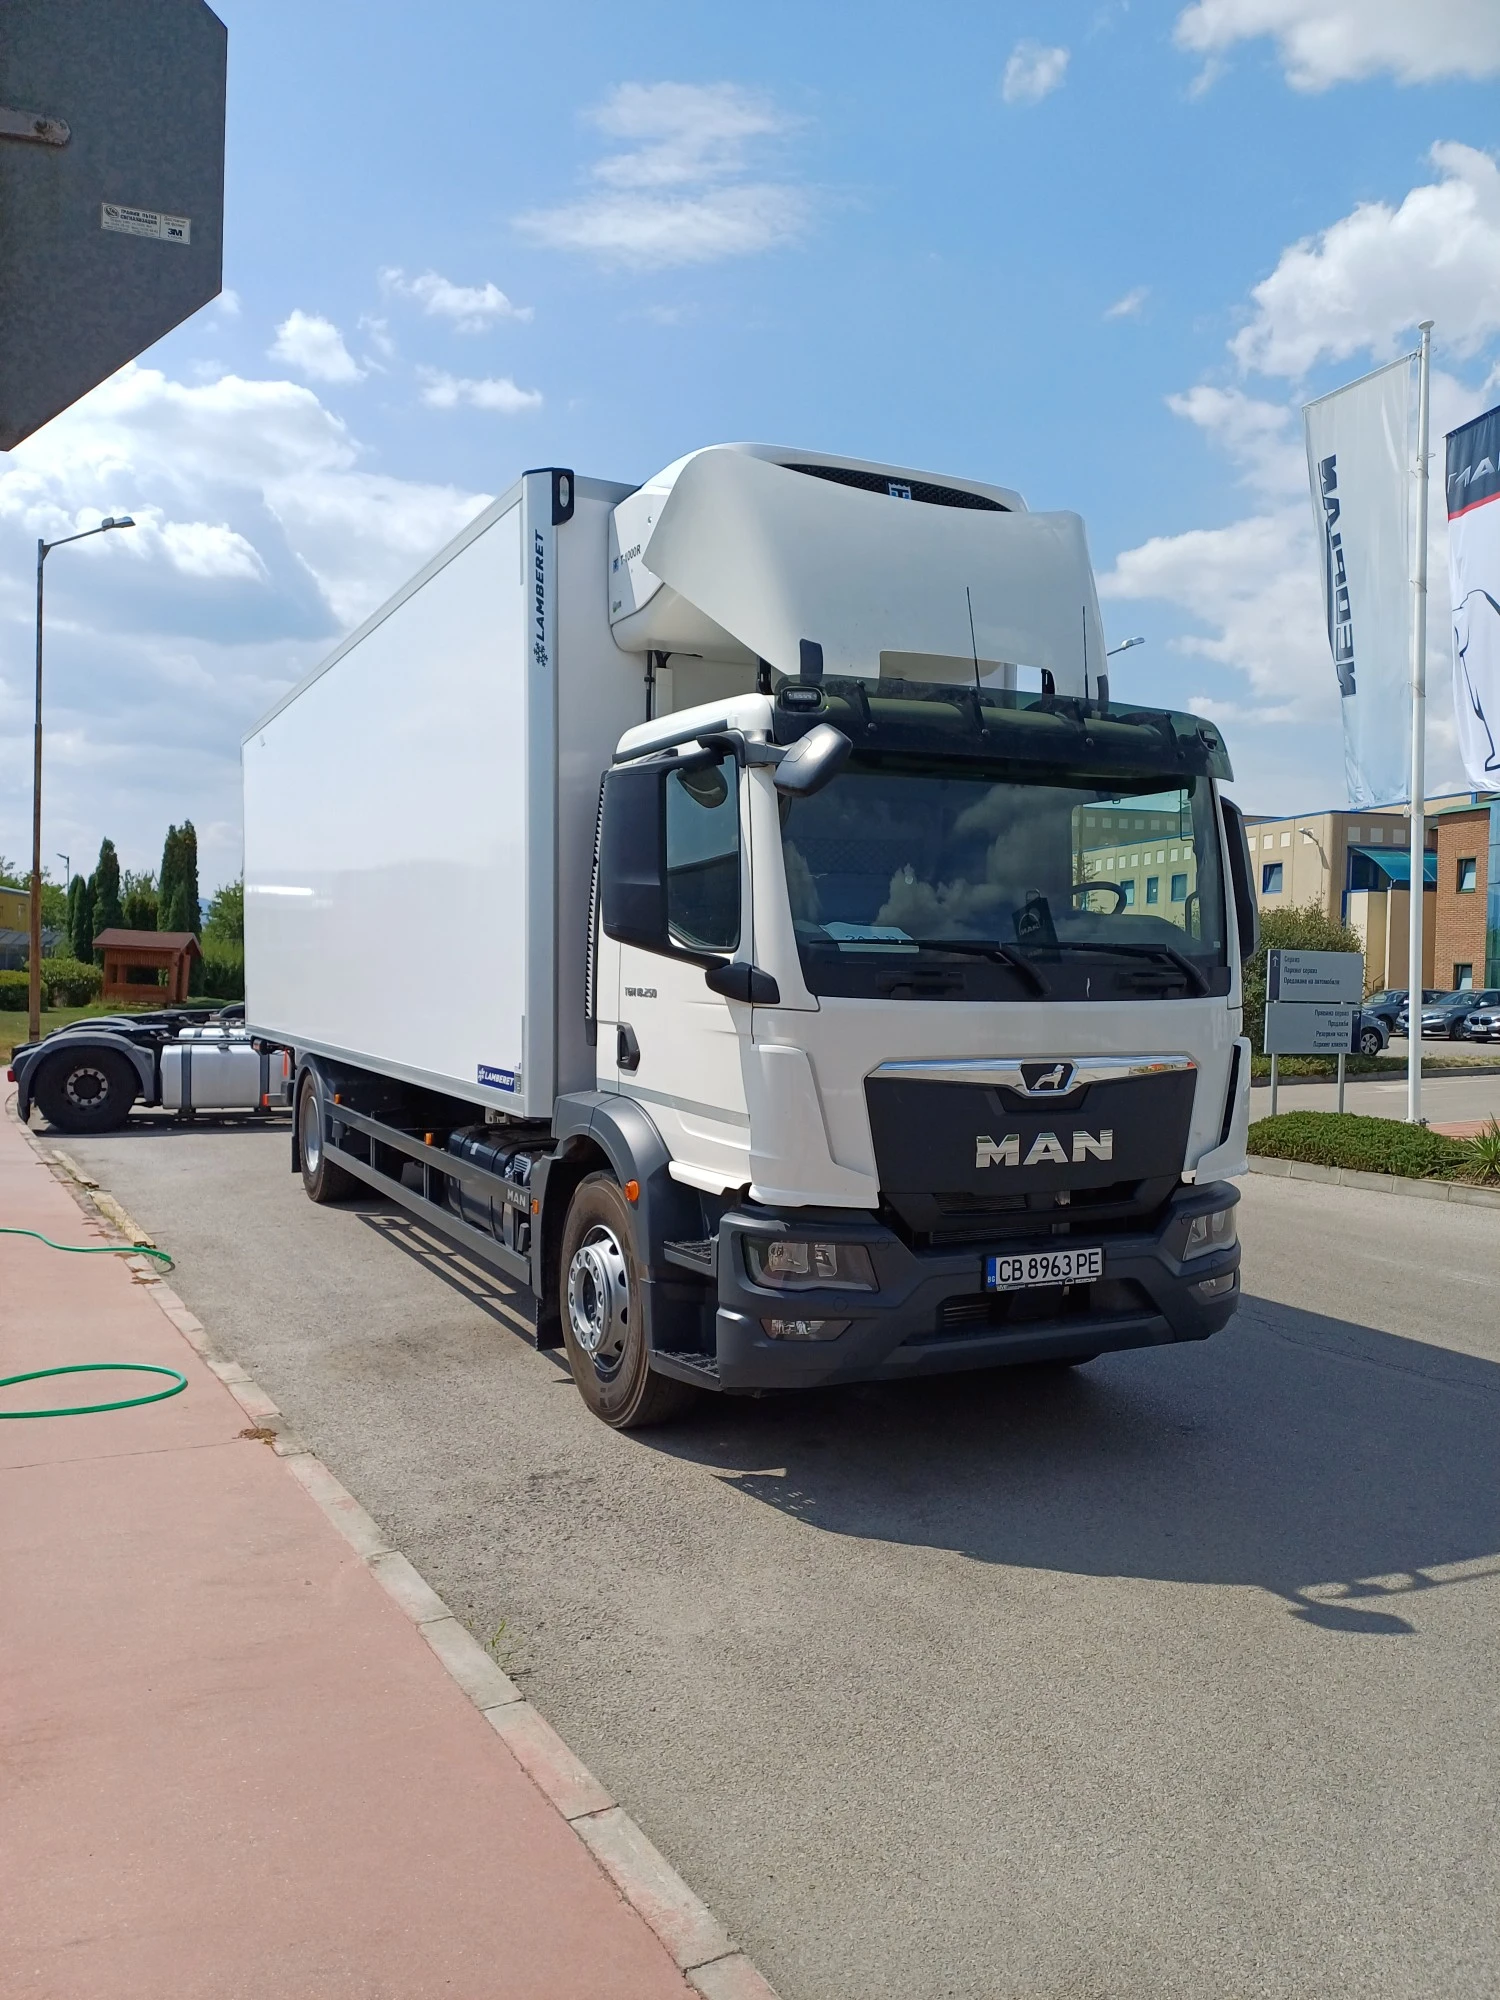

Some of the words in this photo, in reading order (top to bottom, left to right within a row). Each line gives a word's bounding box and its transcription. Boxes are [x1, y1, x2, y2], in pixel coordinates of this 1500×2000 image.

[168, 228, 183, 236] 3M
[535, 529, 545, 642] LAMBERET
[484, 1071, 515, 1087] LAMBERET
[975, 1129, 1114, 1169] MAN
[507, 1188, 526, 1208] MAN
[999, 1258, 1024, 1283] CB
[1027, 1253, 1073, 1280] 8963
[1076, 1251, 1100, 1275] PE
[987, 1275, 996, 1283] BG
